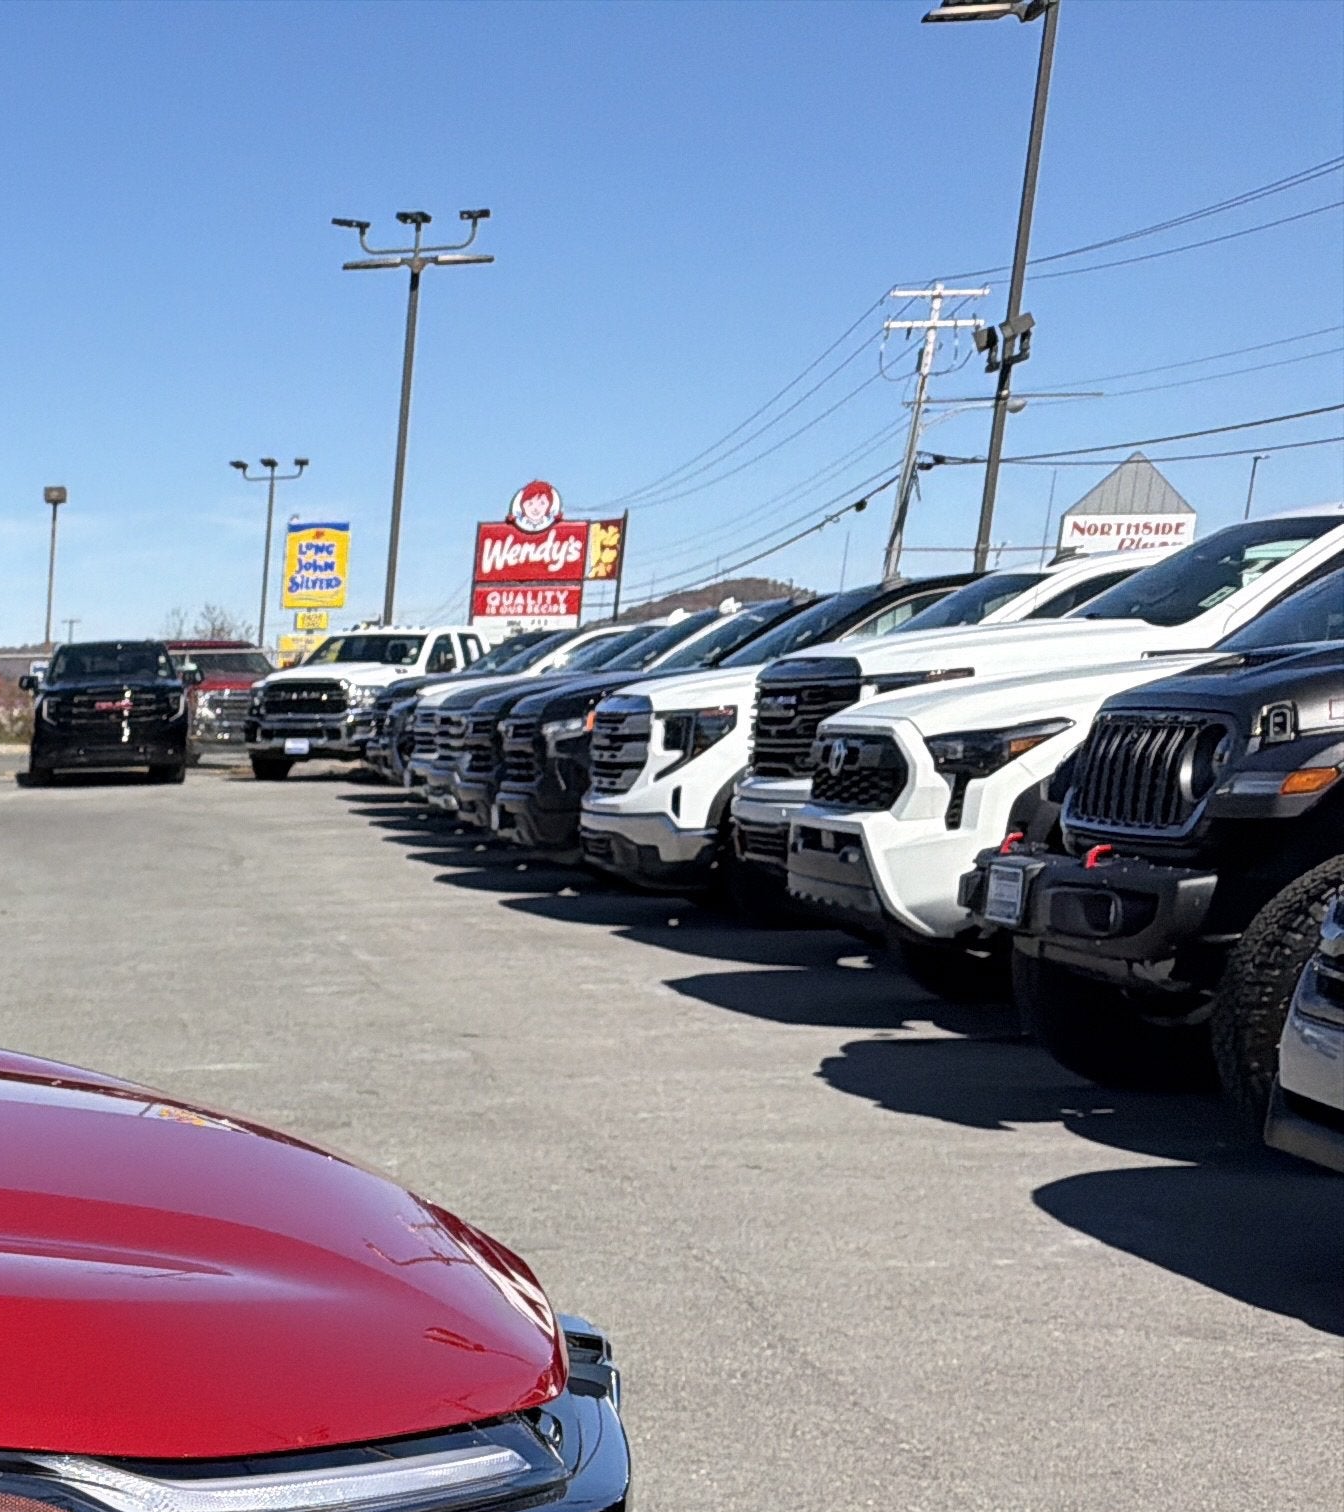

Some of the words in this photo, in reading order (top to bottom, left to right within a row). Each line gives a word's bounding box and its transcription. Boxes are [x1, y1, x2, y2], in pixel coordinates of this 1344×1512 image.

[1070, 520, 1186, 537] NORTHSIDE
[481, 528, 583, 574] Wendy's
[486, 590, 569, 606] QUALITY
